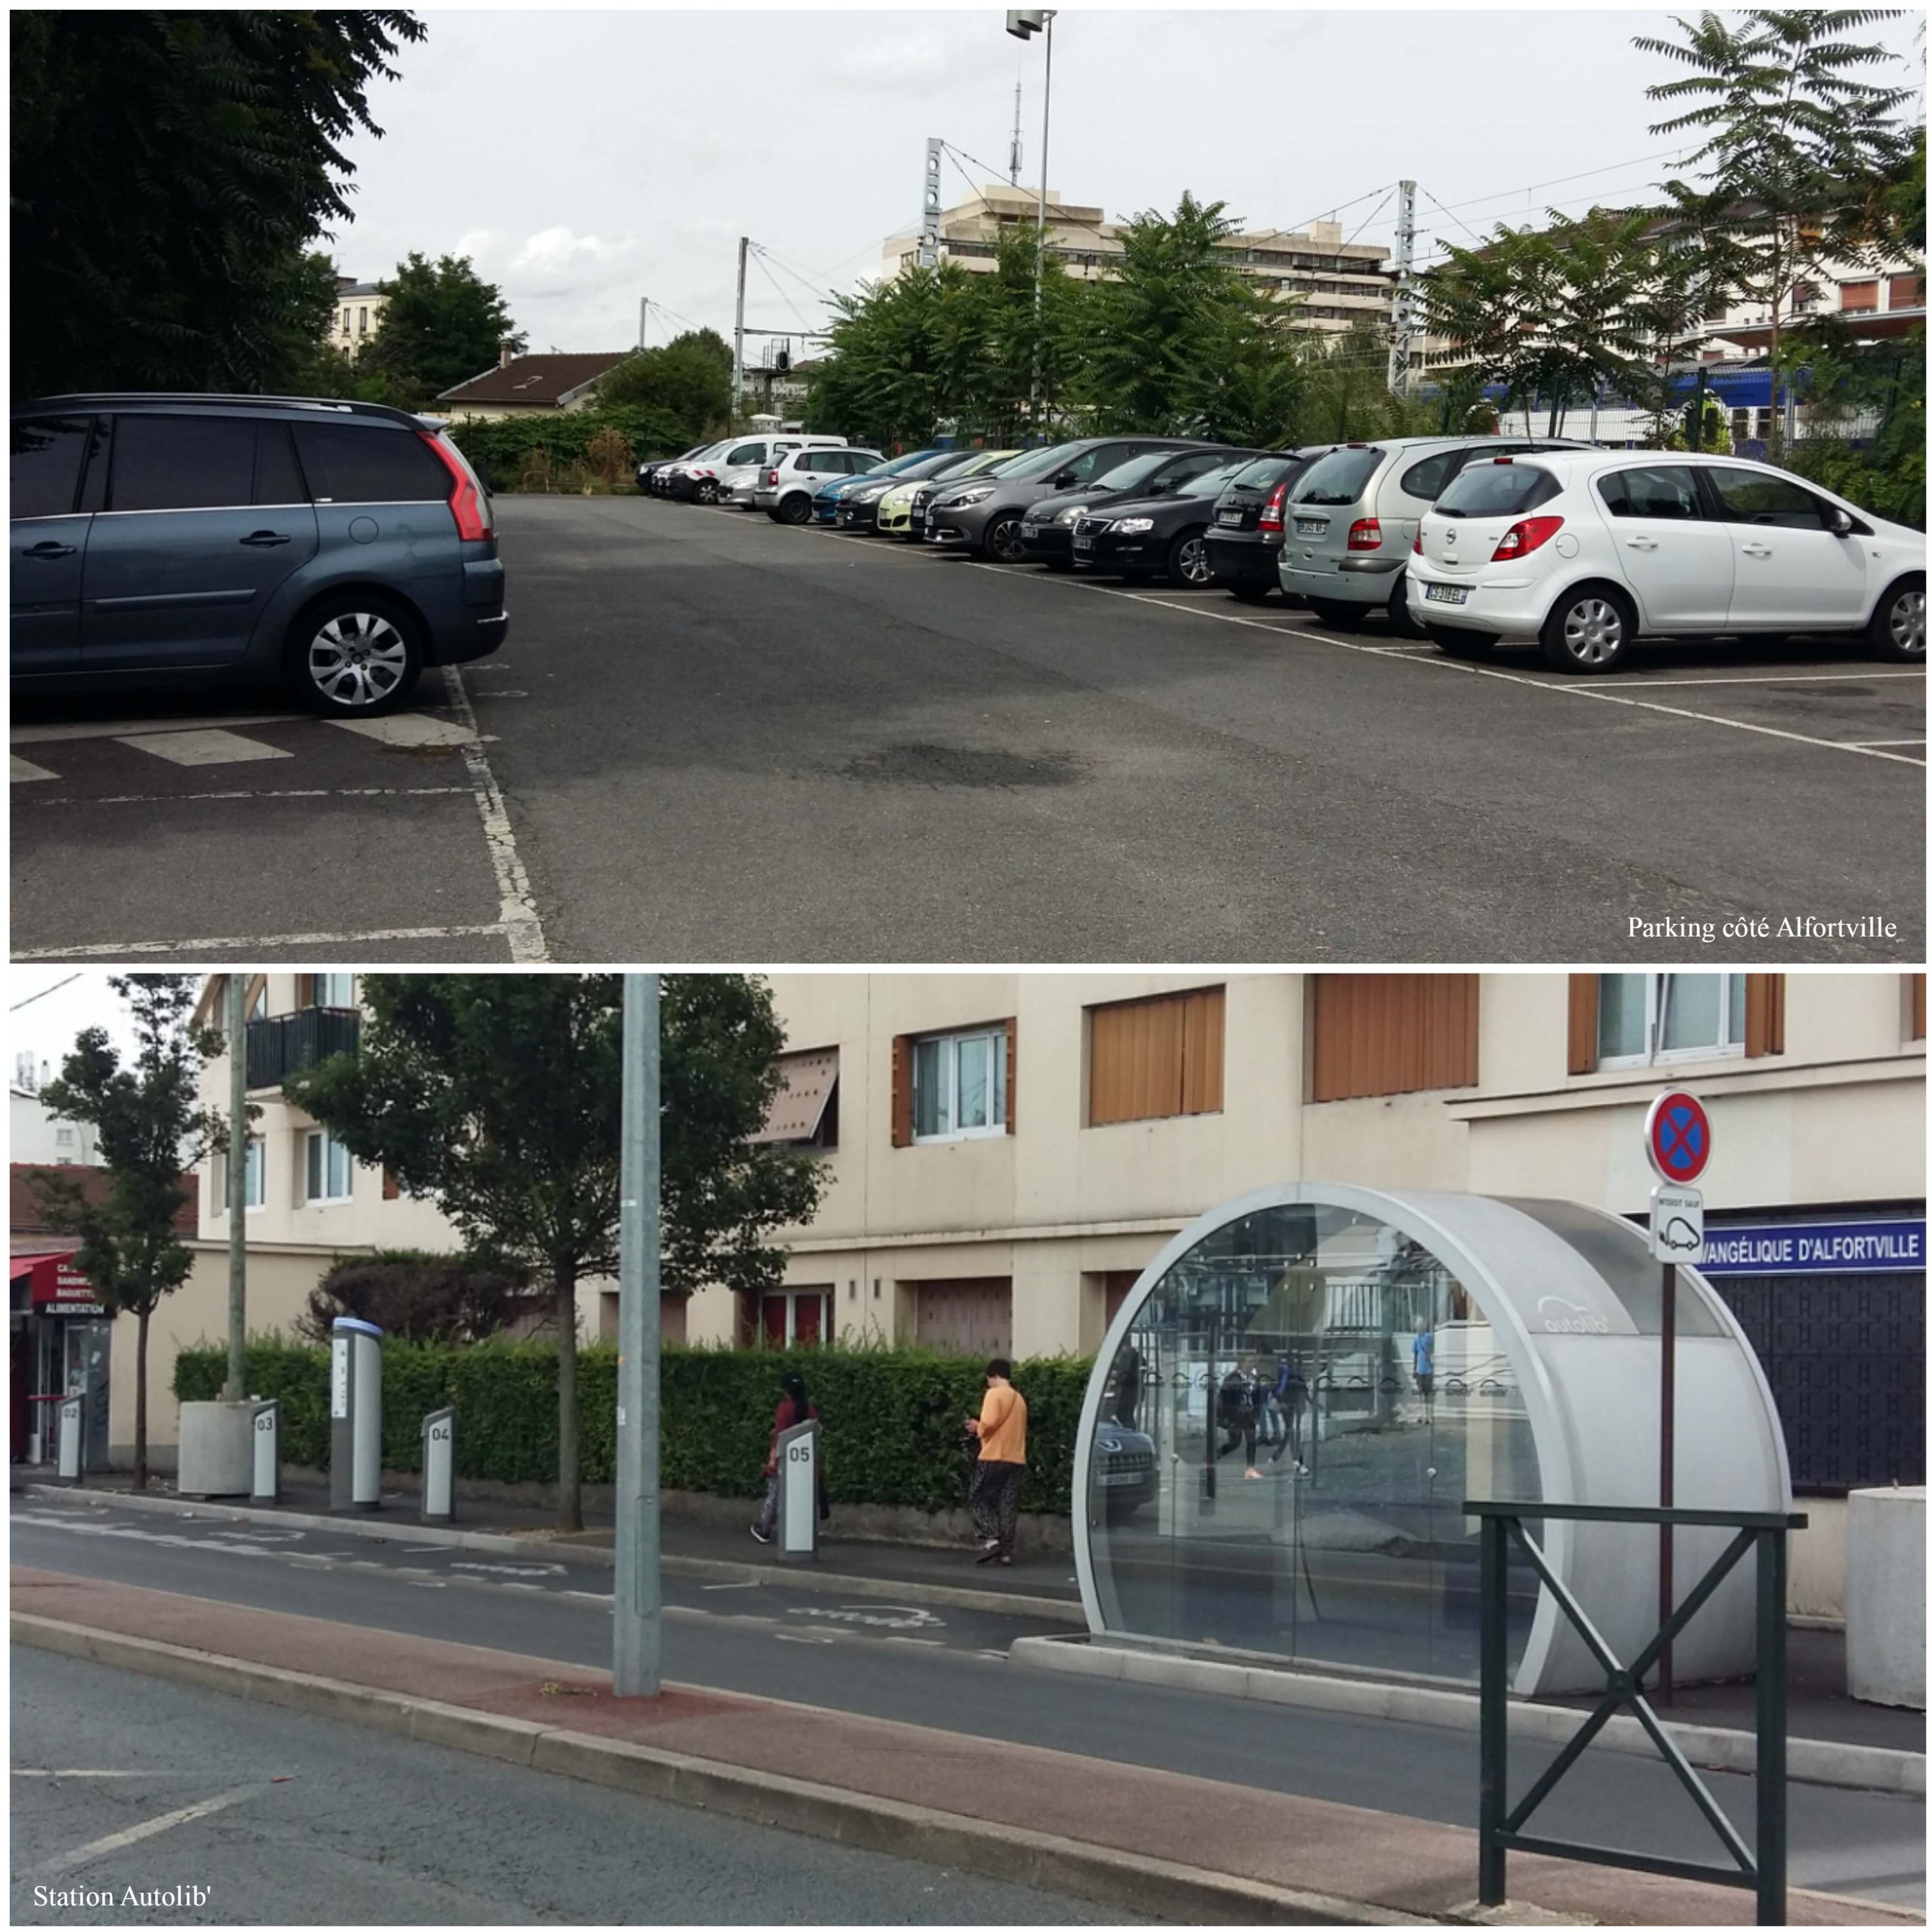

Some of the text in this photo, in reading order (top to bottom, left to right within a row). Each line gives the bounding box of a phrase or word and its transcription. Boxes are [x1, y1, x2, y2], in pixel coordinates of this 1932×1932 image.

[1702, 1234, 1919, 1264] VANGÉLIQUE D'ALFORTVILLE
[46, 1303, 104, 1314] ALIMENTATION
[257, 1417, 272, 1431] 03
[432, 1428, 449, 1441] 04
[790, 1447, 810, 1463] 05
